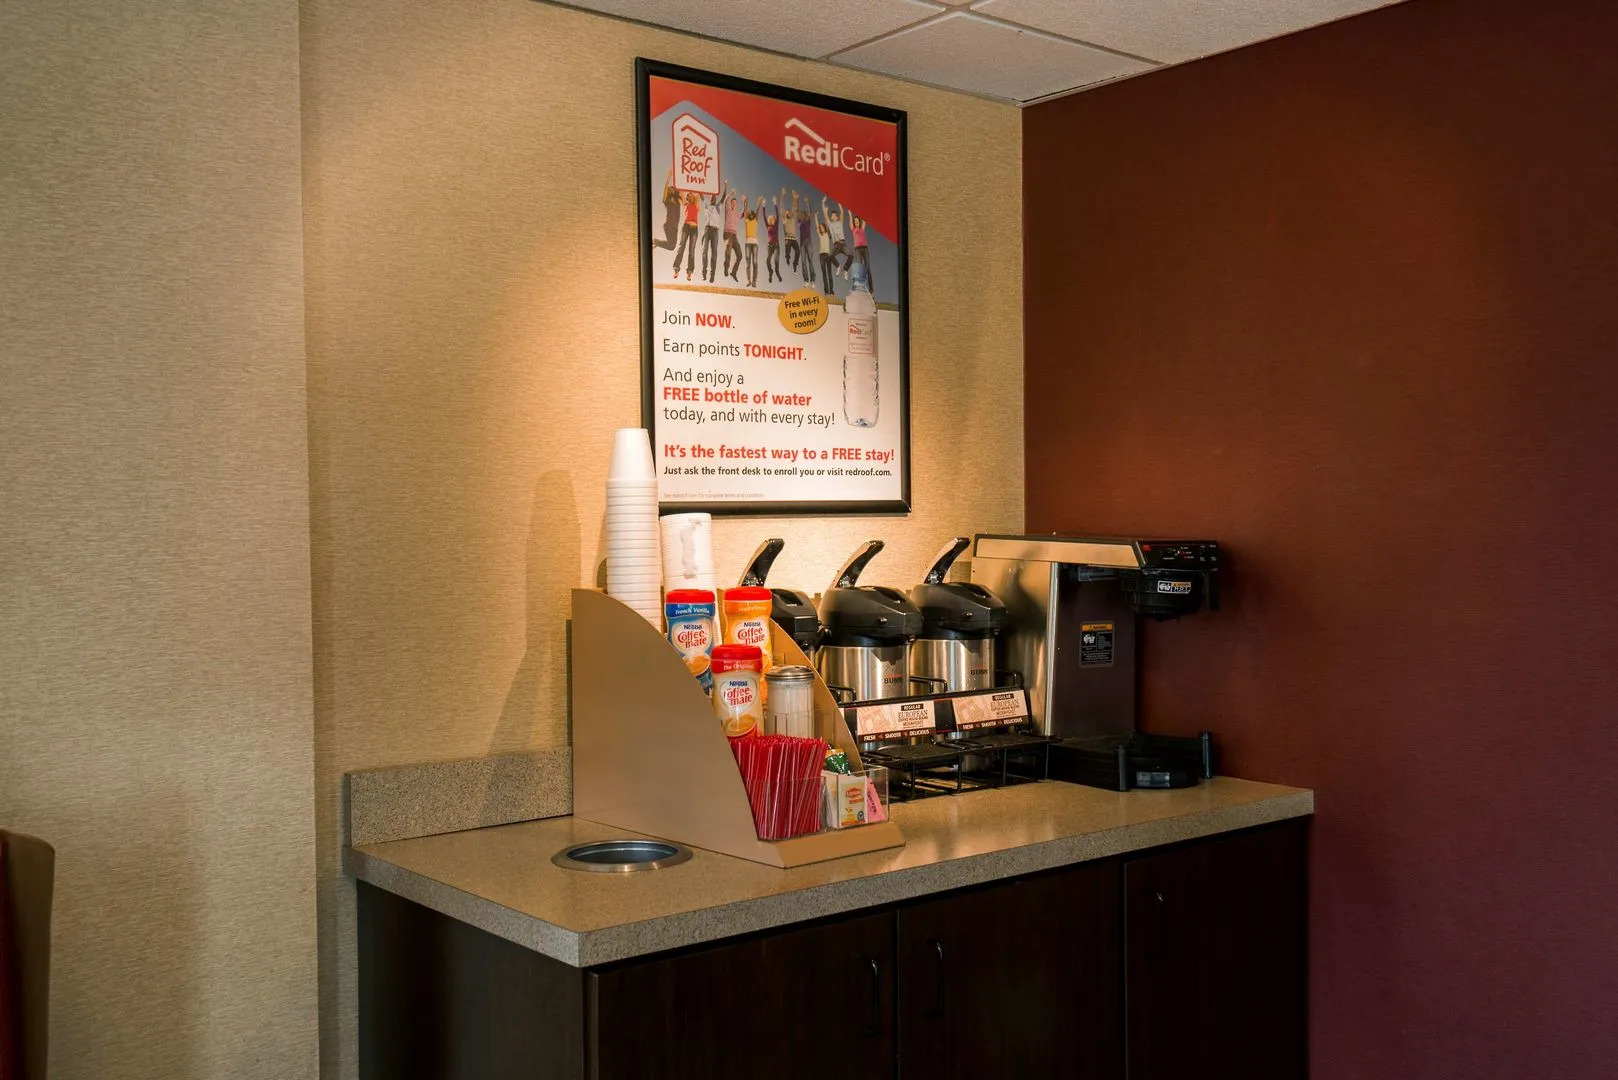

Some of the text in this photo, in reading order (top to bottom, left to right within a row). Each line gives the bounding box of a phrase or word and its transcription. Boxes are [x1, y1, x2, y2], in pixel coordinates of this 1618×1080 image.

[682, 138, 706, 158] Red
[682, 156, 712, 177] Roof
[802, 296, 820, 306] Wi-Fi
[799, 309, 818, 317] every
[663, 311, 735, 329] Join NOW.
[794, 318, 816, 328] room!
[663, 339, 807, 361] Earn points TONIGHT.
[663, 368, 744, 387] And enjoy a
[663, 387, 812, 406] FREE bottle of water
[664, 407, 835, 428] today, and with every stay!
[664, 444, 894, 463] It's the fastest way to a FREE stay!
[664, 466, 682, 476] Just
[684, 467, 699, 475] ask
[701, 467, 715, 475] the
[718, 467, 740, 475] front
[742, 467, 761, 476] desk
[774, 468, 797, 476] enroll
[845, 468, 892, 477] redroof.com.
[675, 606, 692, 615] French
[686, 637, 707, 648] mate
[746, 634, 765, 644] mate
[731, 695, 752, 706] mate
[898, 710, 928, 718] EUROPEAN
